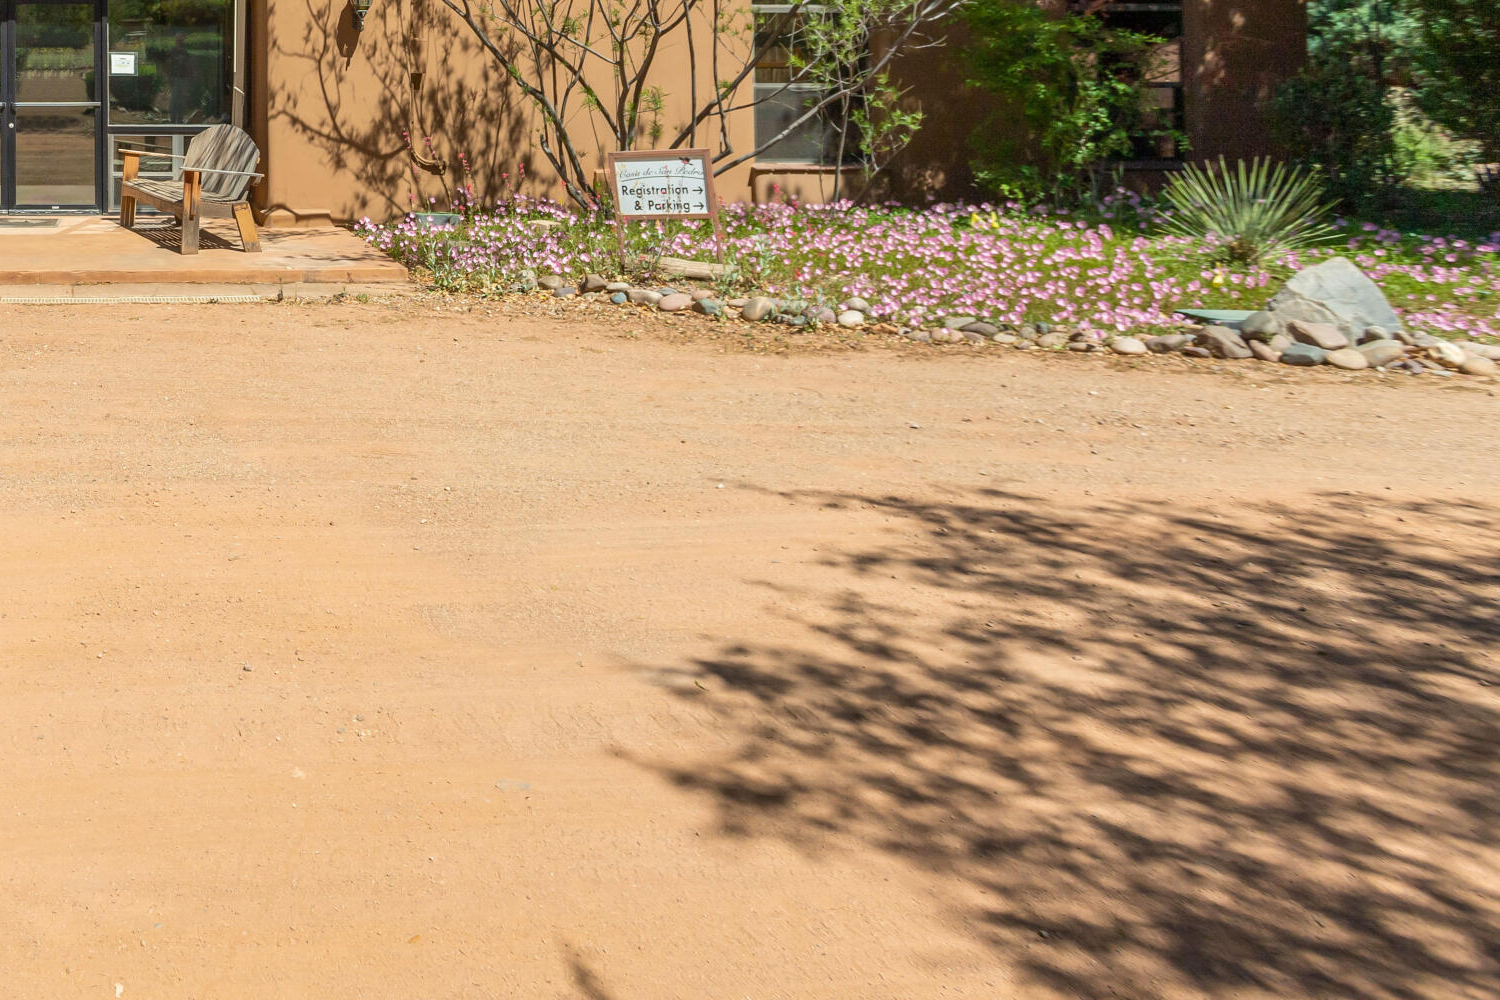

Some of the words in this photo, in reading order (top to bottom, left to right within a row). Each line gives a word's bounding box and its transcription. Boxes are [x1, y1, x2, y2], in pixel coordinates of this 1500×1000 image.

[621, 184, 689, 198] Registration
[634, 200, 642, 211] &
[648, 199, 690, 213] Parking
